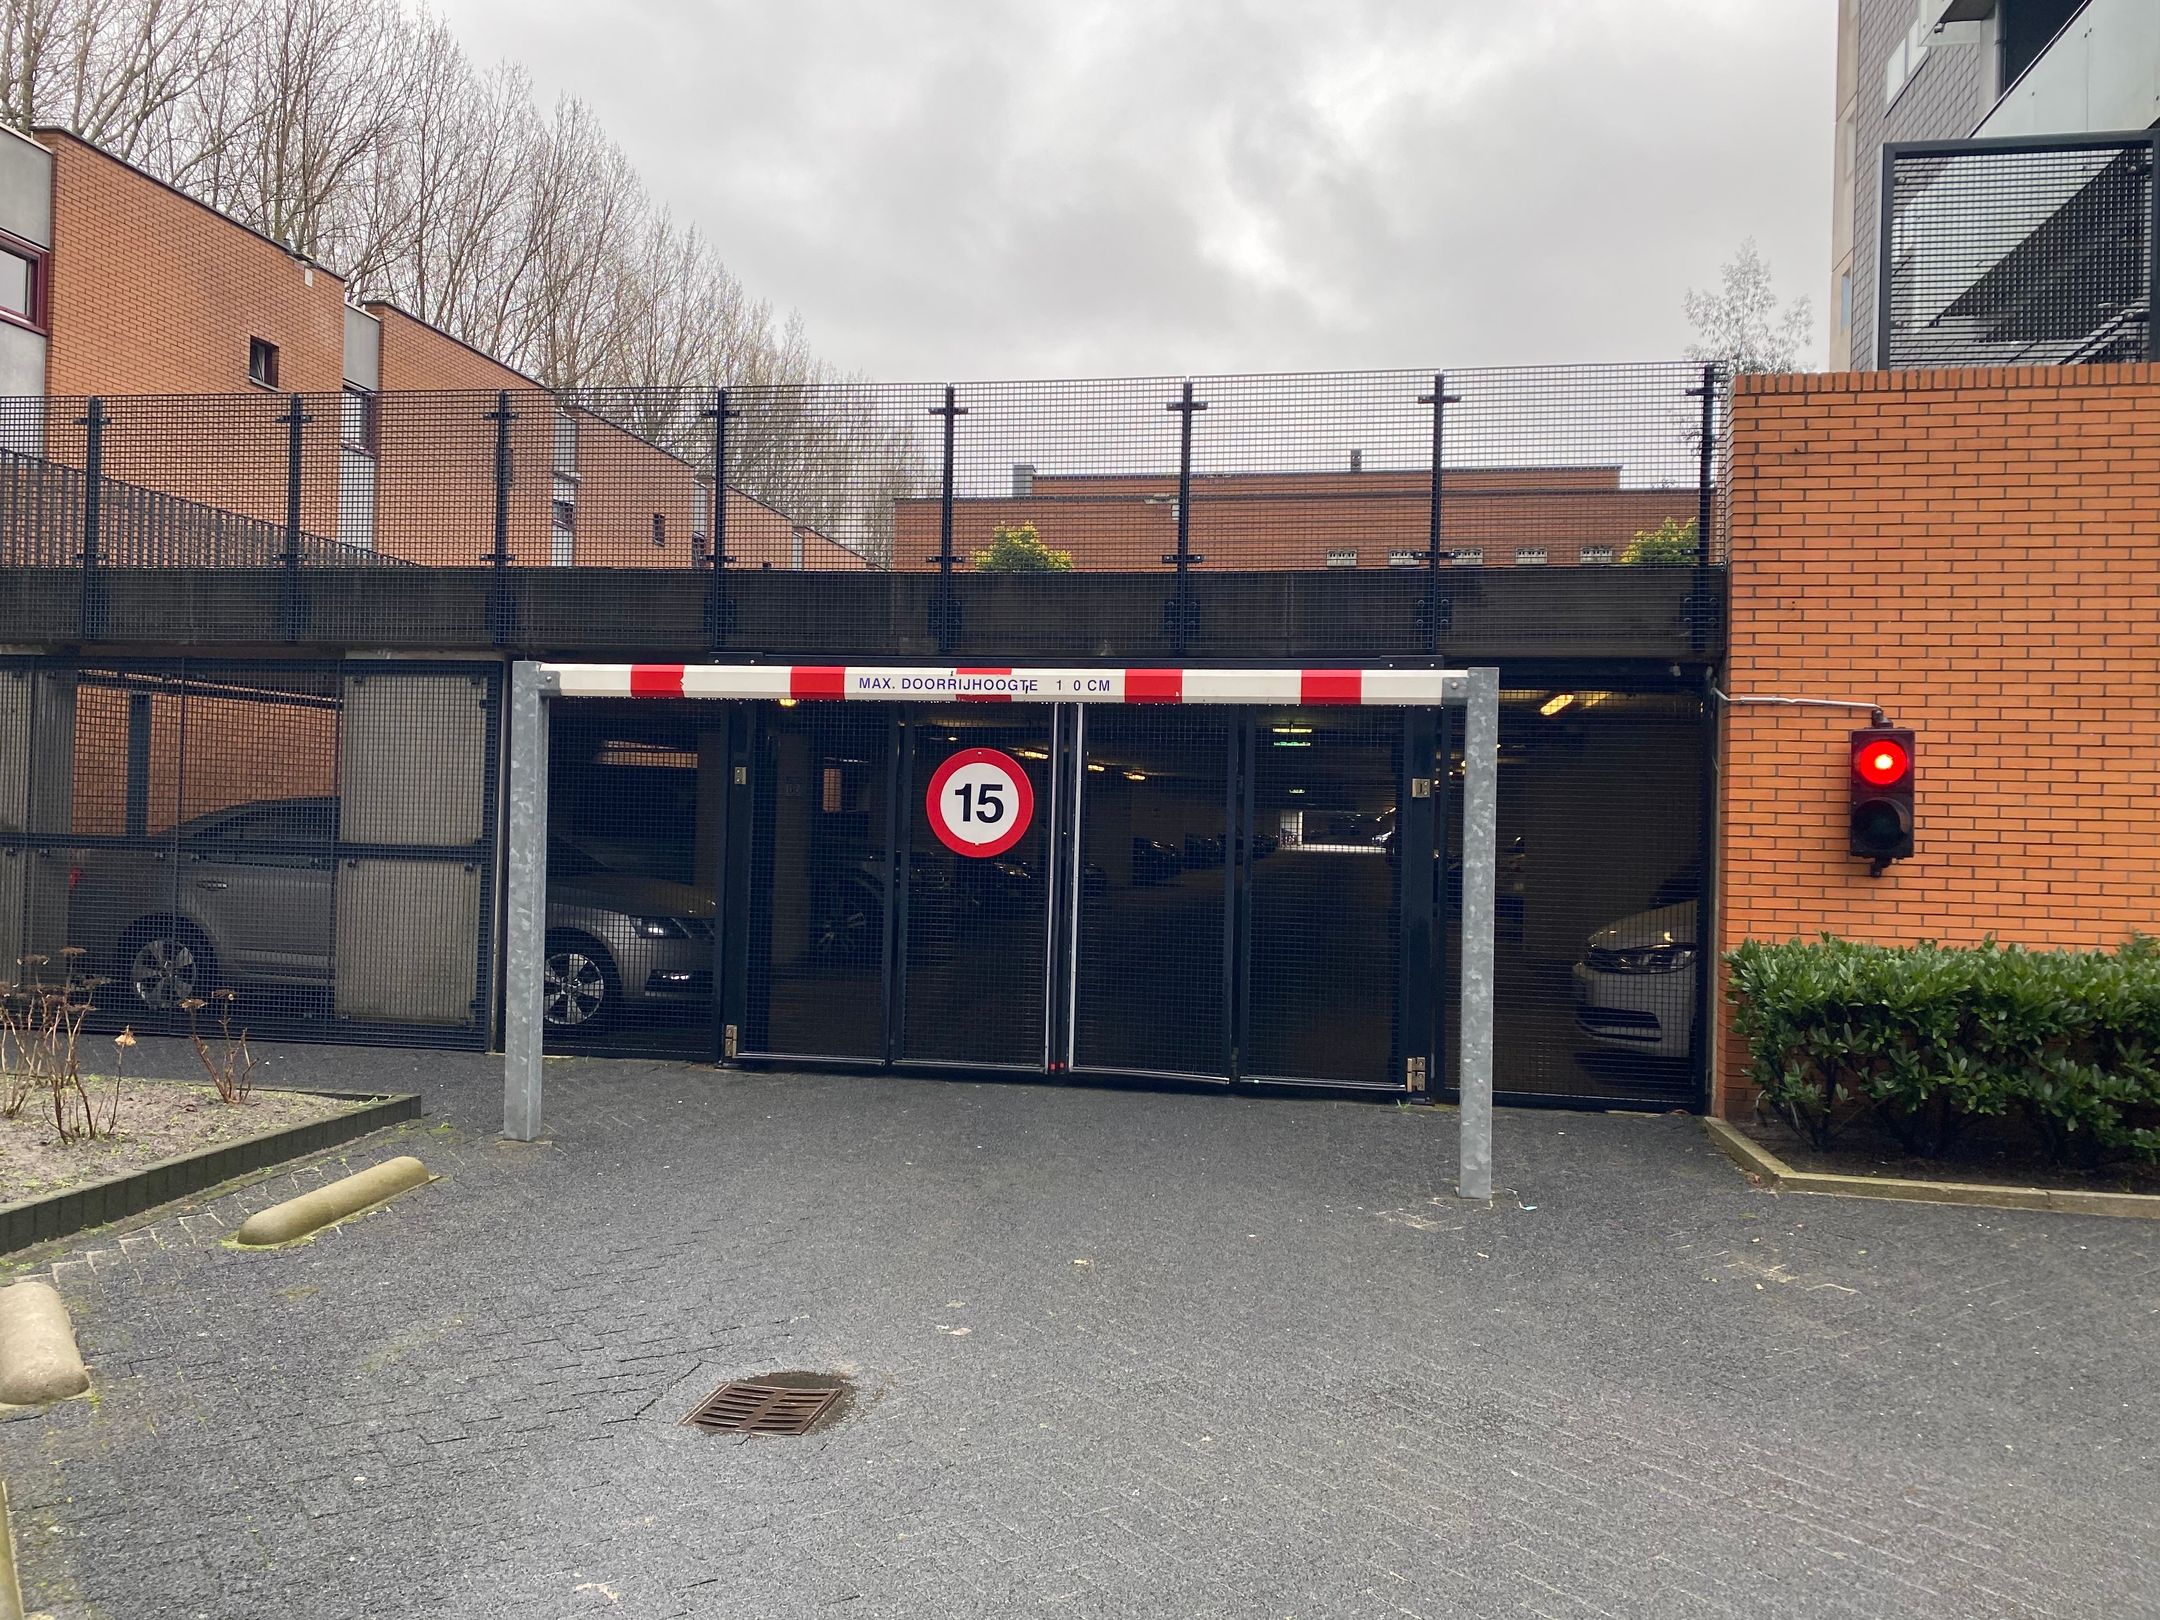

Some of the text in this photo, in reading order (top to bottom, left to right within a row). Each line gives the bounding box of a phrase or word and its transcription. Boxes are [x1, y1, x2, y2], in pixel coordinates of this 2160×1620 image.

[859, 677, 896, 690] MAX.
[901, 678, 1038, 692] DOORRIJHOOGTE
[1087, 679, 1110, 692] CM
[954, 783, 1005, 824] 15
